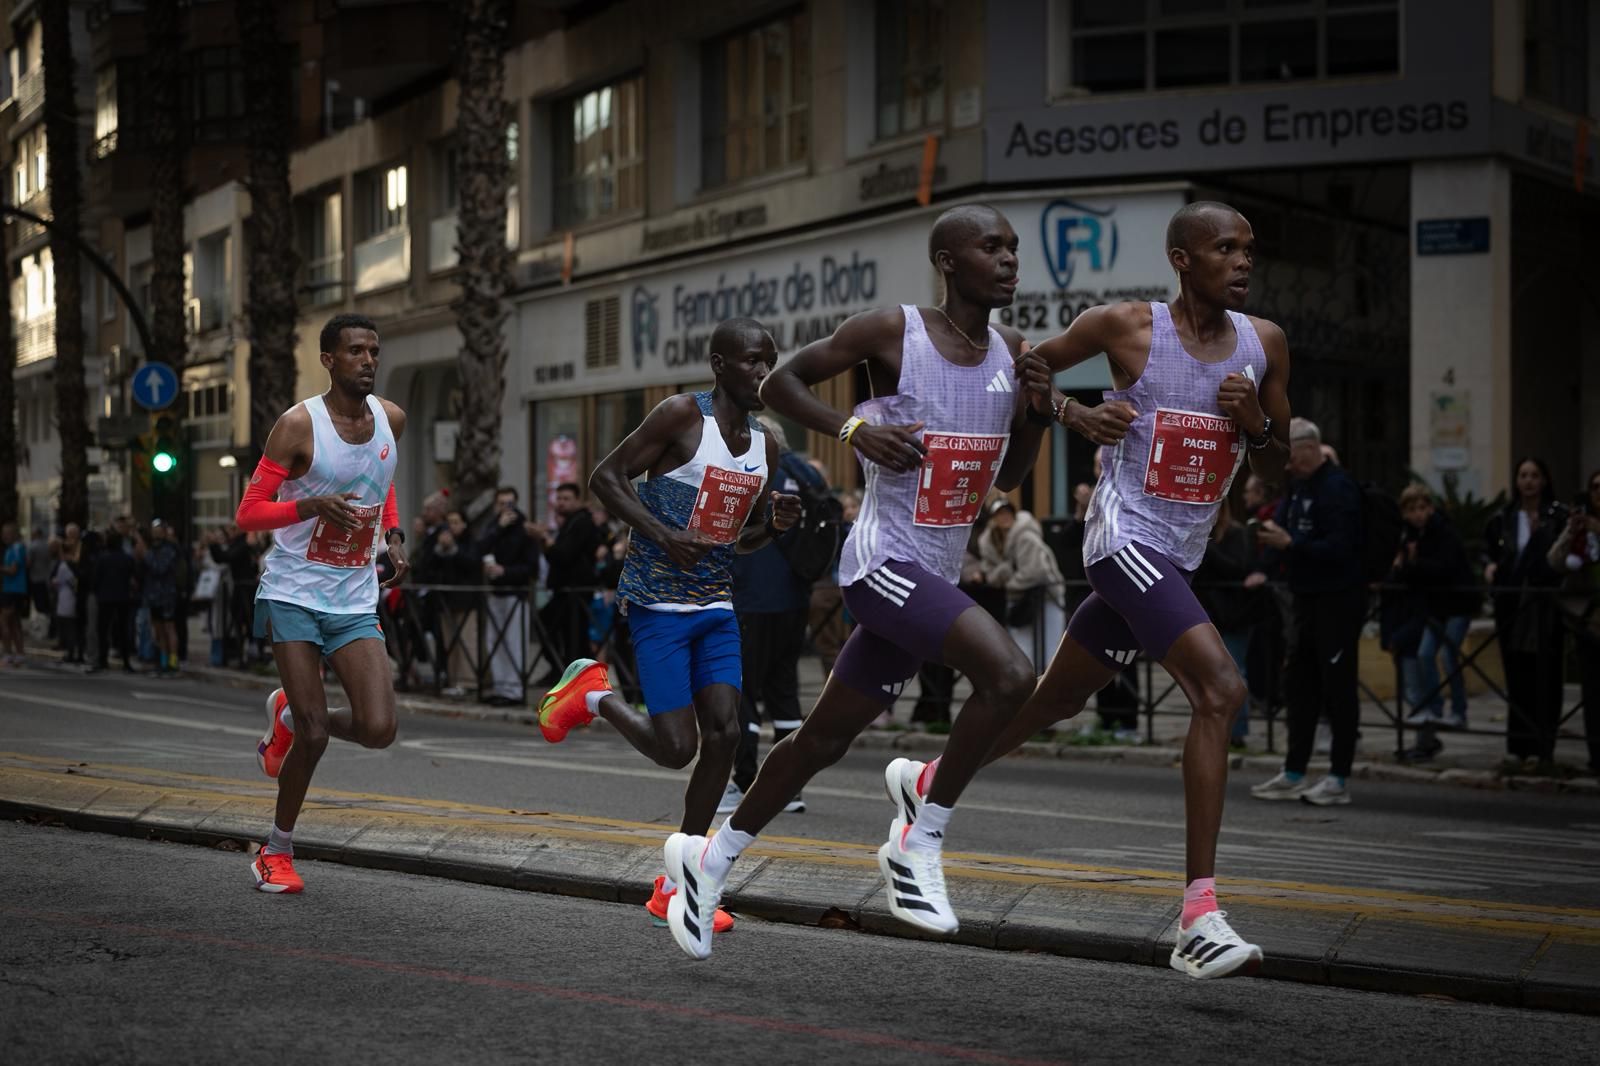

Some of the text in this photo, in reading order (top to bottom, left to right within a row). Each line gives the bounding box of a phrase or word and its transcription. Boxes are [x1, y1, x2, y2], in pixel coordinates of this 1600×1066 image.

[1006, 100, 1470, 158] Asesores de Empresas
[673, 251, 877, 330] Fernández de Rota
[1000, 304, 1048, 328] 952
[949, 437, 1001, 451] GENERALI
[1183, 437, 1217, 451] PACER
[951, 460, 982, 471] PACER
[1189, 455, 1204, 466] 21
[724, 471, 760, 487] GENERALI
[956, 477, 970, 488] 22
[723, 495, 741, 506] DICH
[725, 504, 735, 514] 13
[345, 534, 352, 542] 7
